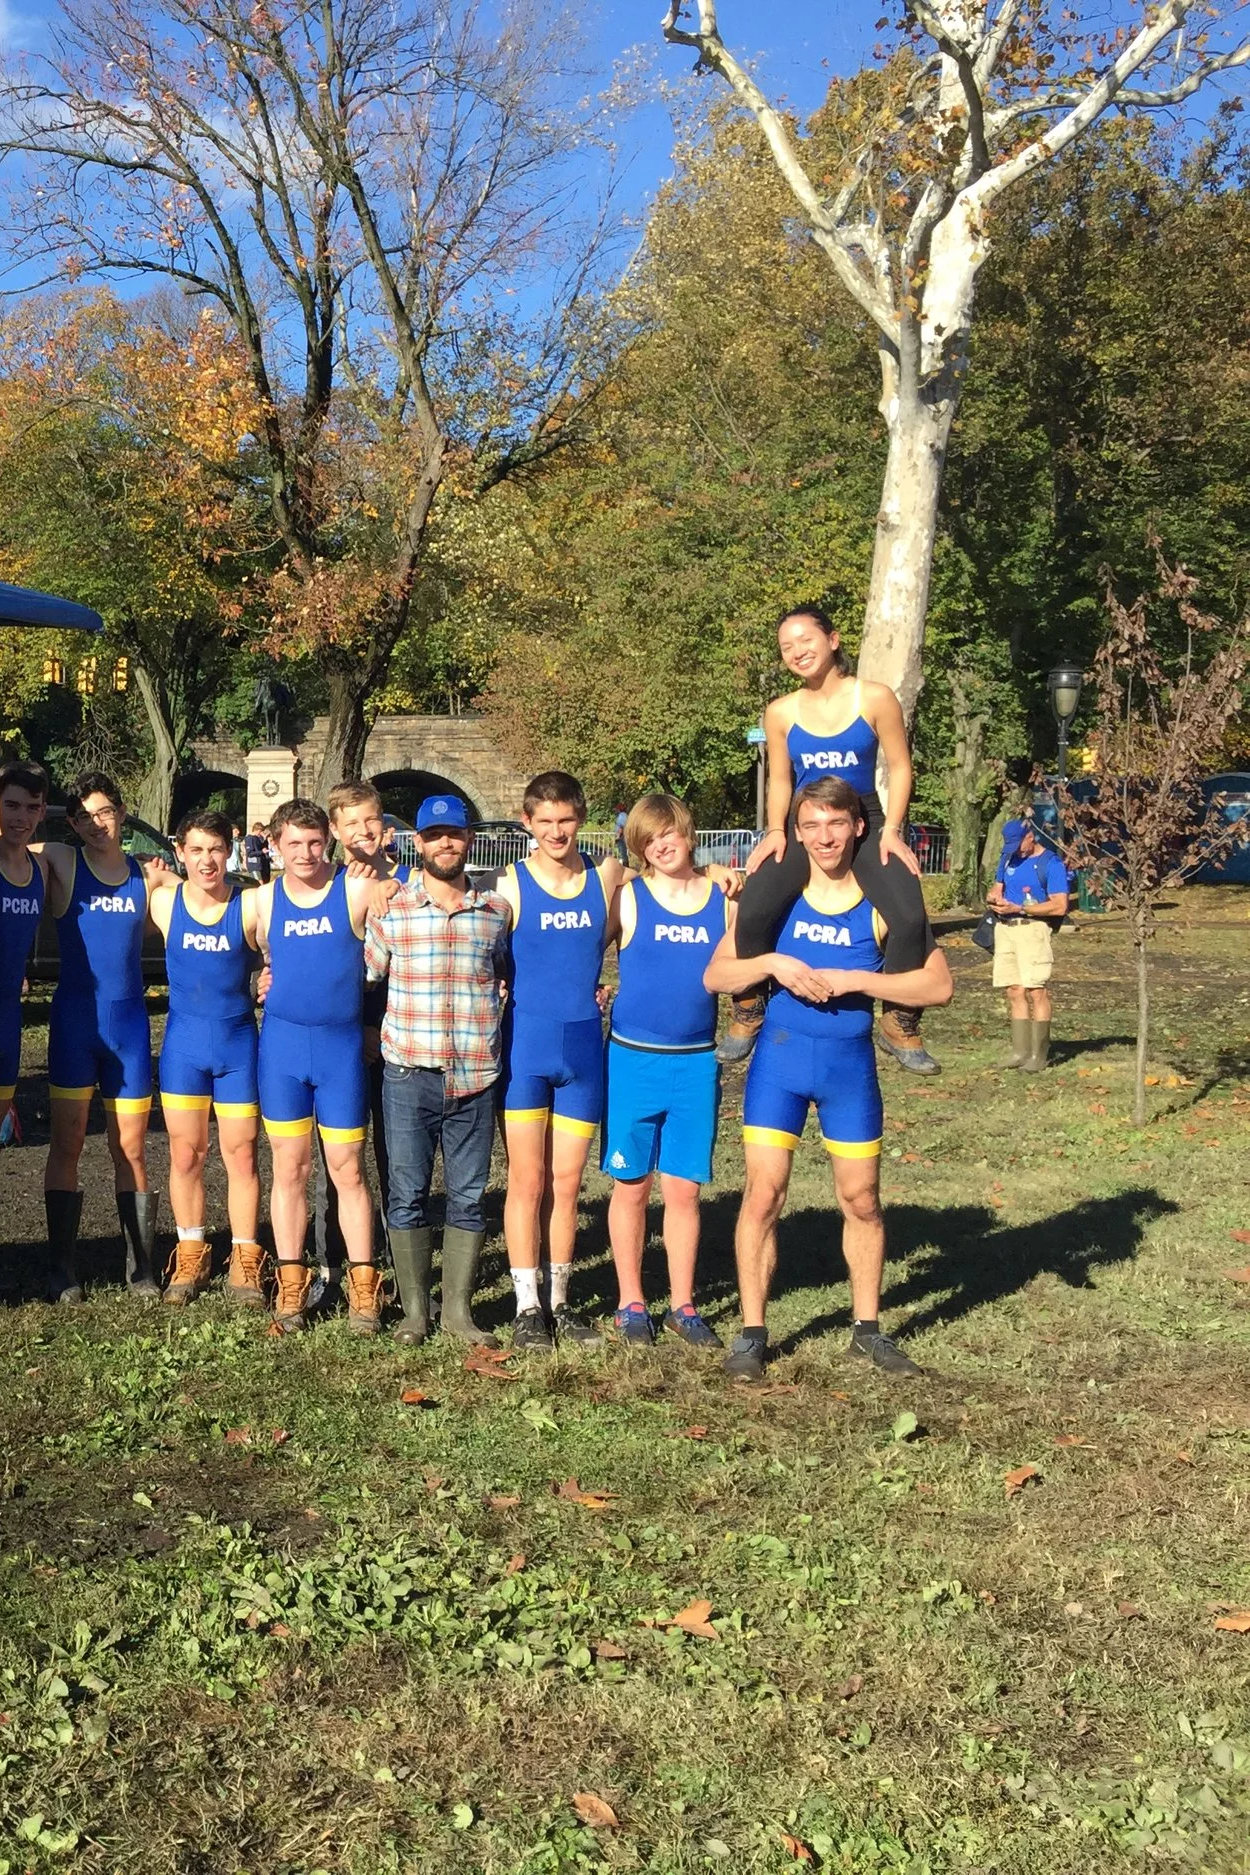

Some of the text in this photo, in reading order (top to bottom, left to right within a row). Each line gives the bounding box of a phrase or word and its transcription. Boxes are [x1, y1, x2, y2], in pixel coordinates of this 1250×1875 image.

[800, 750, 859, 770] PCRA
[2, 896, 39, 914] PCRA
[89, 895, 136, 912] PCRA
[284, 916, 333, 937] PCRA
[540, 910, 592, 930] PCRA
[182, 932, 230, 951] PCRA
[654, 924, 710, 944] PCRA
[793, 920, 852, 946] PCRA
